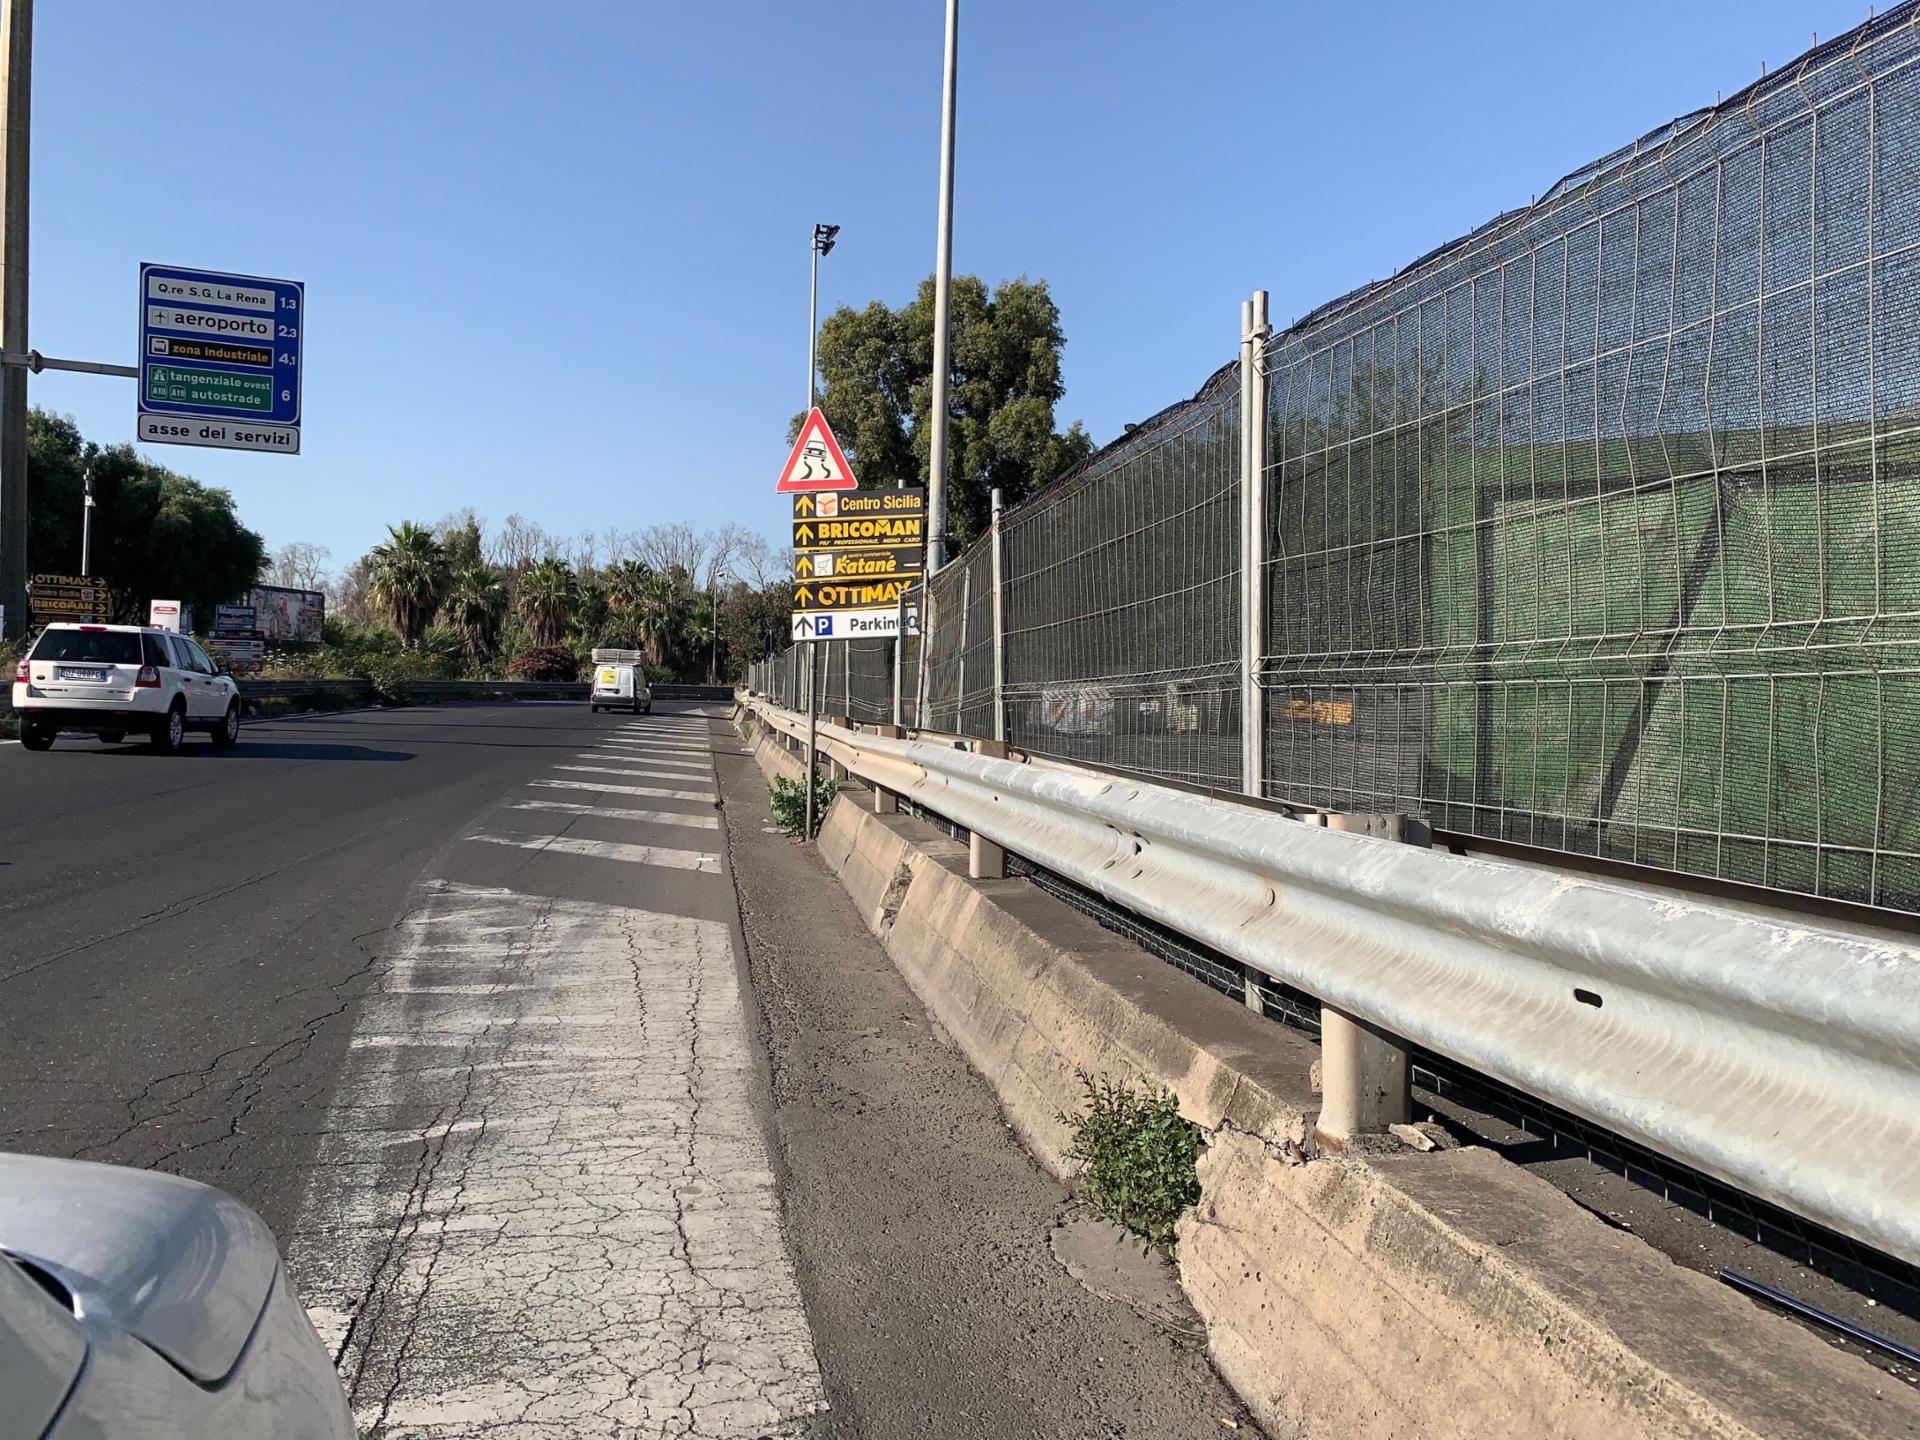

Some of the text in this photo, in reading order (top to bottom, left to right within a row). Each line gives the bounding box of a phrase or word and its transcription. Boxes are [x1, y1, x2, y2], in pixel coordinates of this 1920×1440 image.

[158, 283, 184, 294] Q.re
[217, 290, 232, 301] La
[236, 293, 267, 305] Rena
[174, 312, 268, 334] aeroporto
[172, 344, 269, 363] zona industriale
[170, 372, 271, 391] tangenziale ovest
[191, 389, 262, 405] autostrade
[281, 389, 291, 402] 6
[148, 423, 291, 446] asse dei servizi
[841, 494, 921, 511] Centro Sicilia
[818, 519, 920, 539] BRICOMAN
[34, 574, 92, 586] OTTIMAX
[818, 580, 912, 606] OTTIMAX
[34, 600, 93, 610] BRICOMAN
